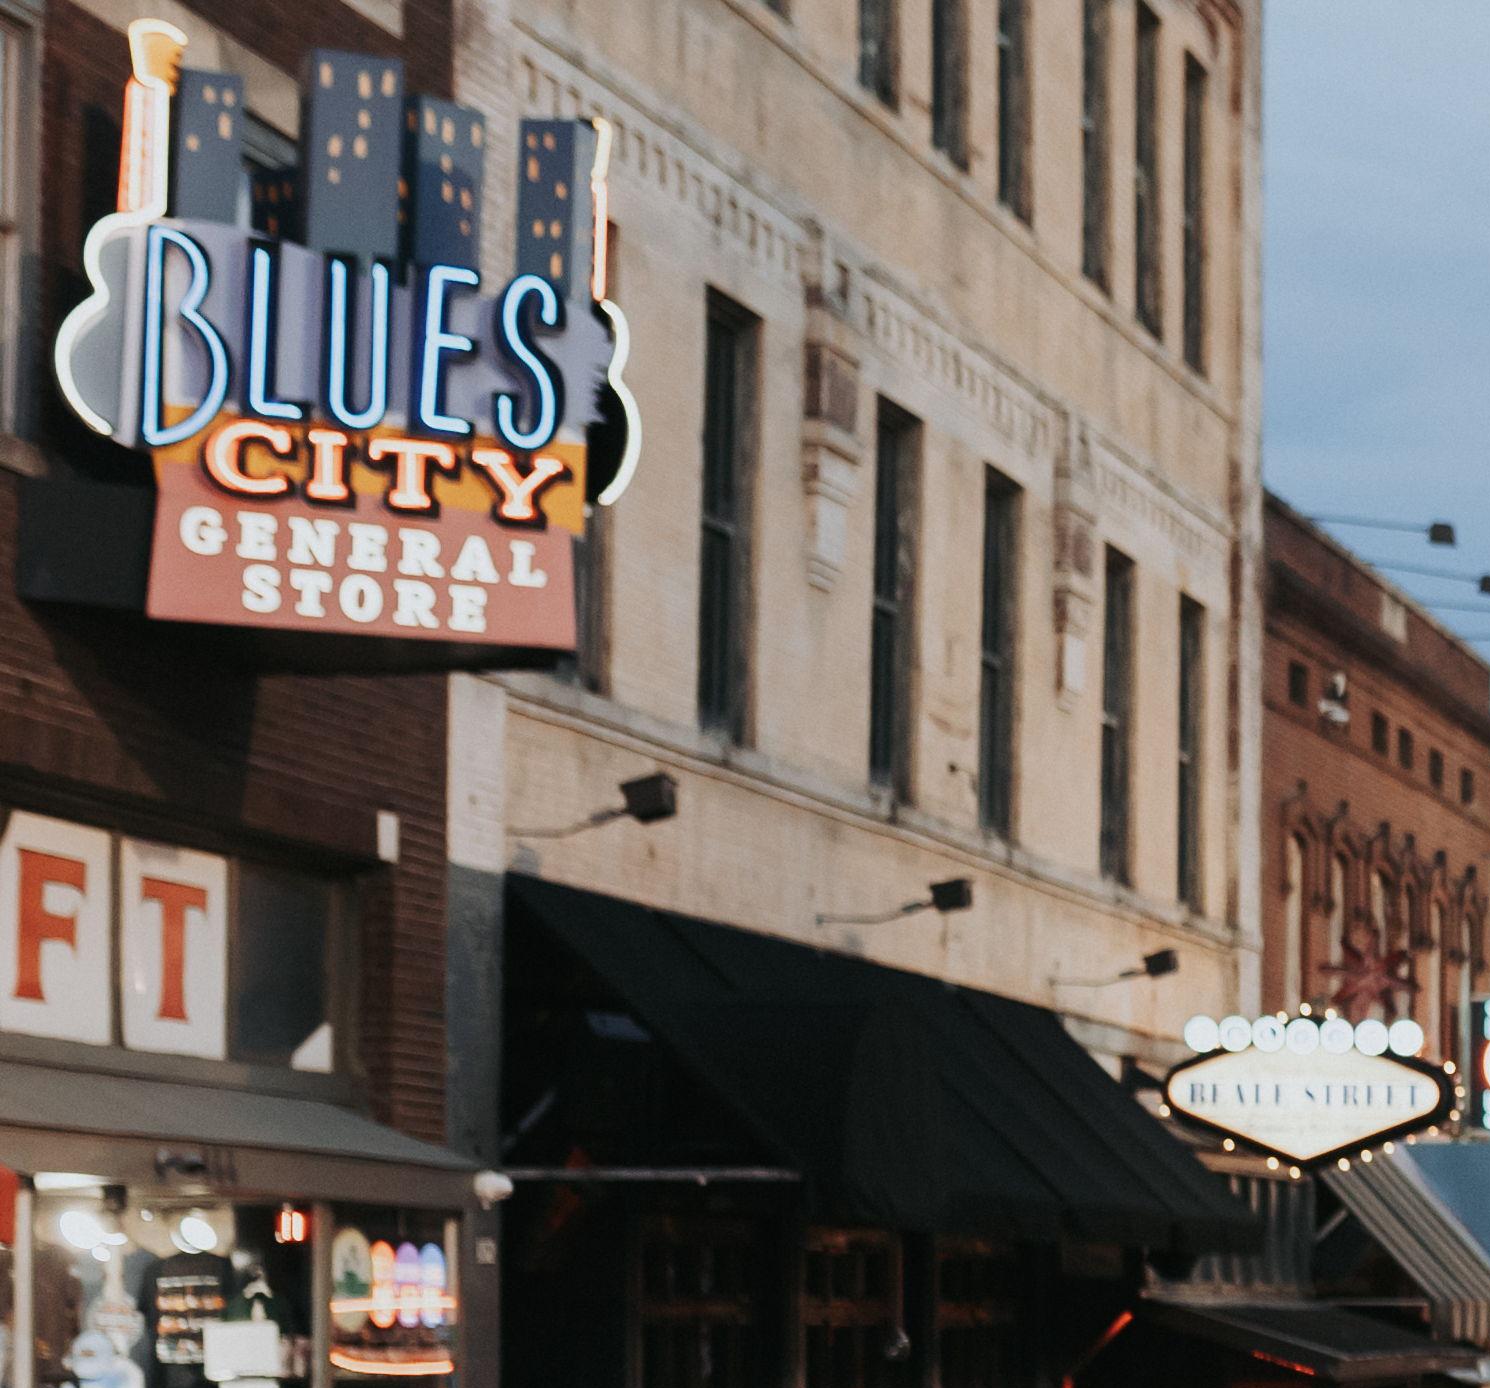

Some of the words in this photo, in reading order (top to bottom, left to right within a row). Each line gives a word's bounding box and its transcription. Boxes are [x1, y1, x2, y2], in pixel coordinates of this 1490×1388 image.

[143, 224, 560, 449] BLUES
[204, 421, 563, 519] CITY
[179, 505, 548, 588] GENERAL
[241, 565, 488, 633] STORE
[1189, 1083, 1283, 1105] BEALE
[1304, 1084, 1417, 1107] STREET
